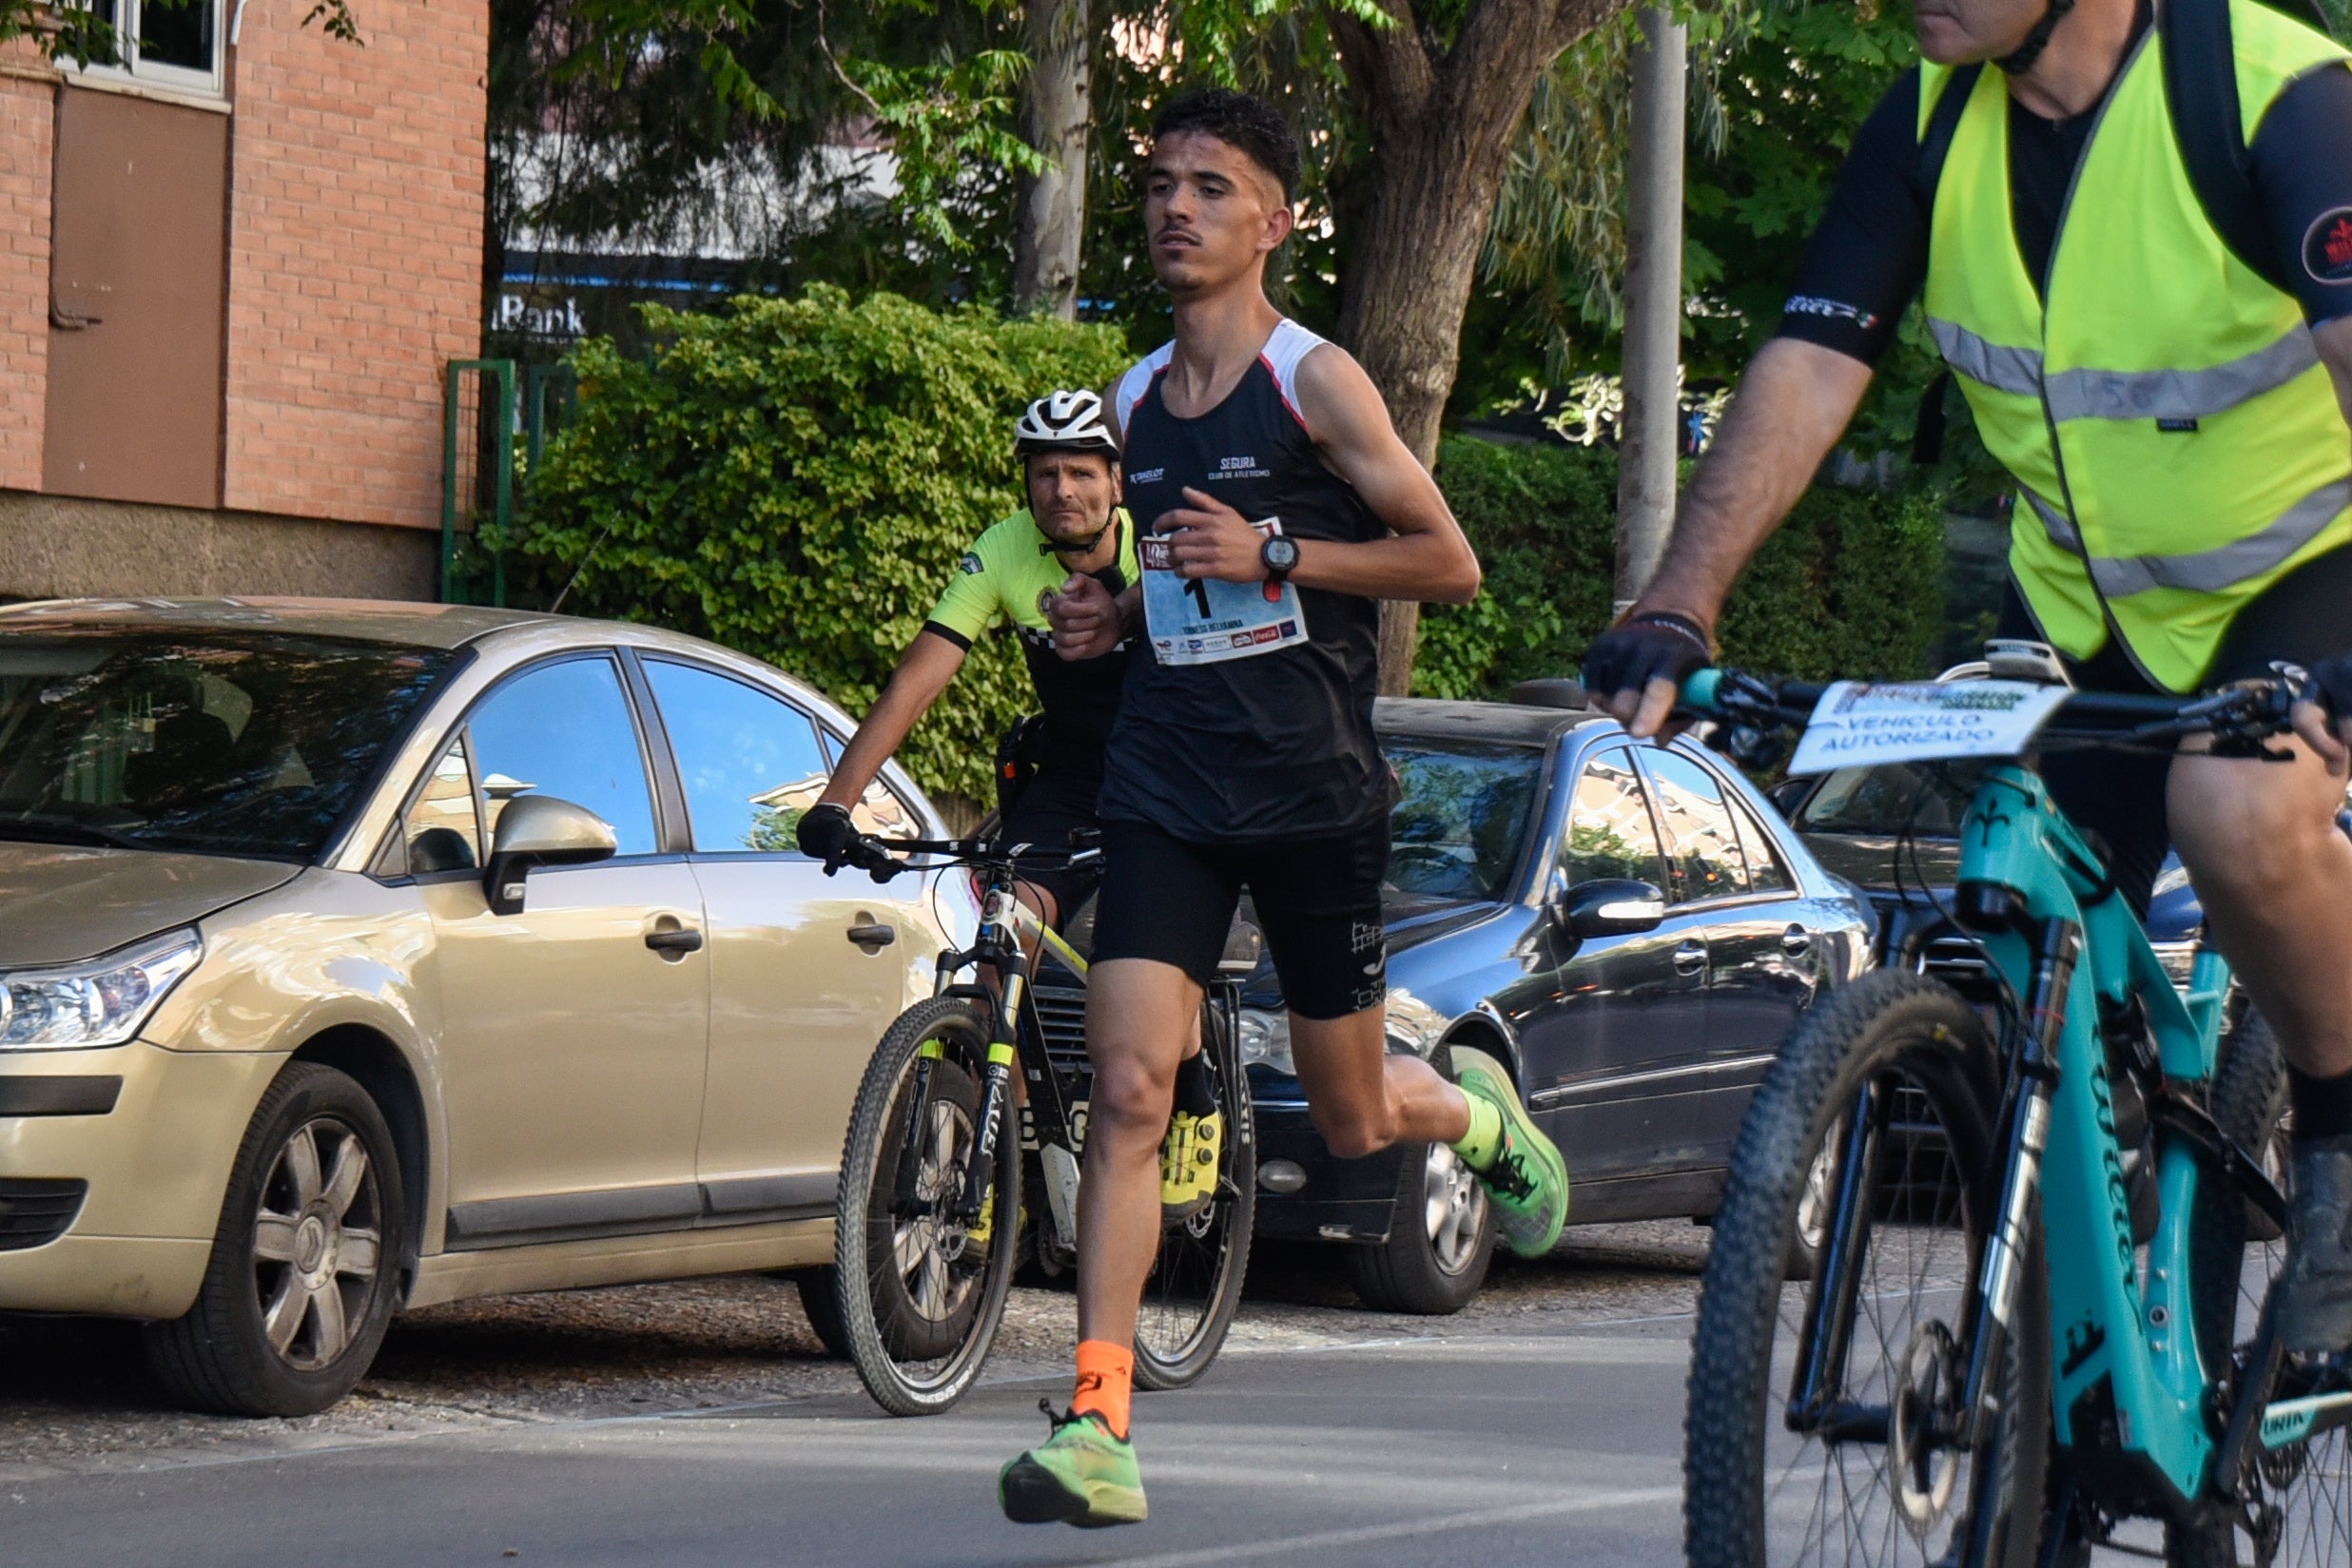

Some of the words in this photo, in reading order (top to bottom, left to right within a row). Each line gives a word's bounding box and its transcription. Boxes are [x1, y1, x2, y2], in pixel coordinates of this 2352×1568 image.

[1220, 456, 1256, 470] SEGURA
[1208, 471, 1224, 480] CLUB
[1224, 471, 1233, 479] DE
[1234, 469, 1271, 478] ATLETISMO
[1183, 577, 1212, 619] 1
[1819, 728, 1994, 752] AUTORIZADO
